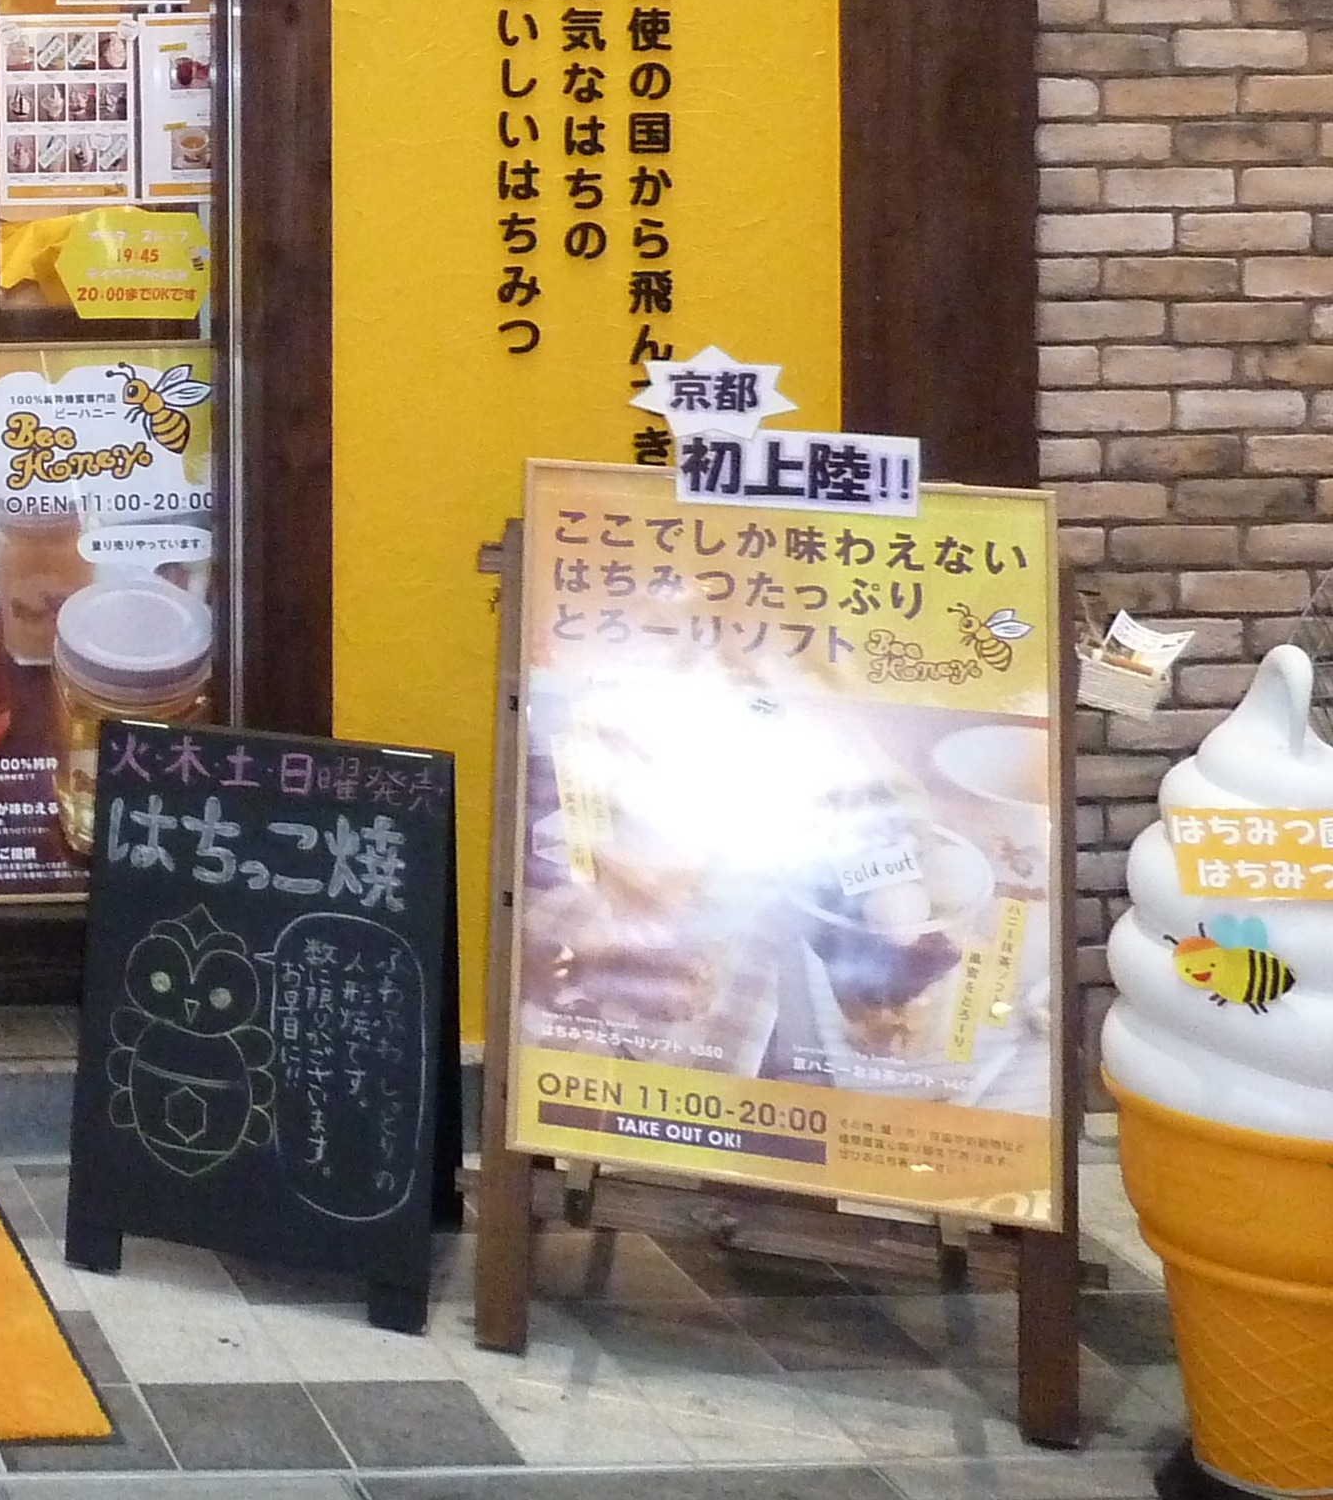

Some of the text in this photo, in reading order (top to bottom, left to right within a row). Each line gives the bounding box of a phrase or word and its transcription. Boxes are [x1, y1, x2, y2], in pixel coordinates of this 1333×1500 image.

[669, 371, 759, 413] 京都
[2, 412, 76, 449] Bee
[54, 408, 117, 419] ビーハニー
[7, 442, 147, 490] Honey
[680, 436, 914, 502] 初上陸!!
[6, 496, 68, 514] OPEN
[555, 509, 1028, 577] ここでしか味わえない
[554, 557, 924, 621] はちみつたっぷり
[553, 604, 856, 663] とろーりソフト
[865, 629, 923, 660] Bee
[867, 657, 979, 685] Honey
[107, 794, 406, 912] はちっこ焼
[886, 852, 916, 875] out
[538, 1073, 827, 1134] OPEN 11:00-20:00
[617, 1116, 742, 1150] TAKE OUT OK!
